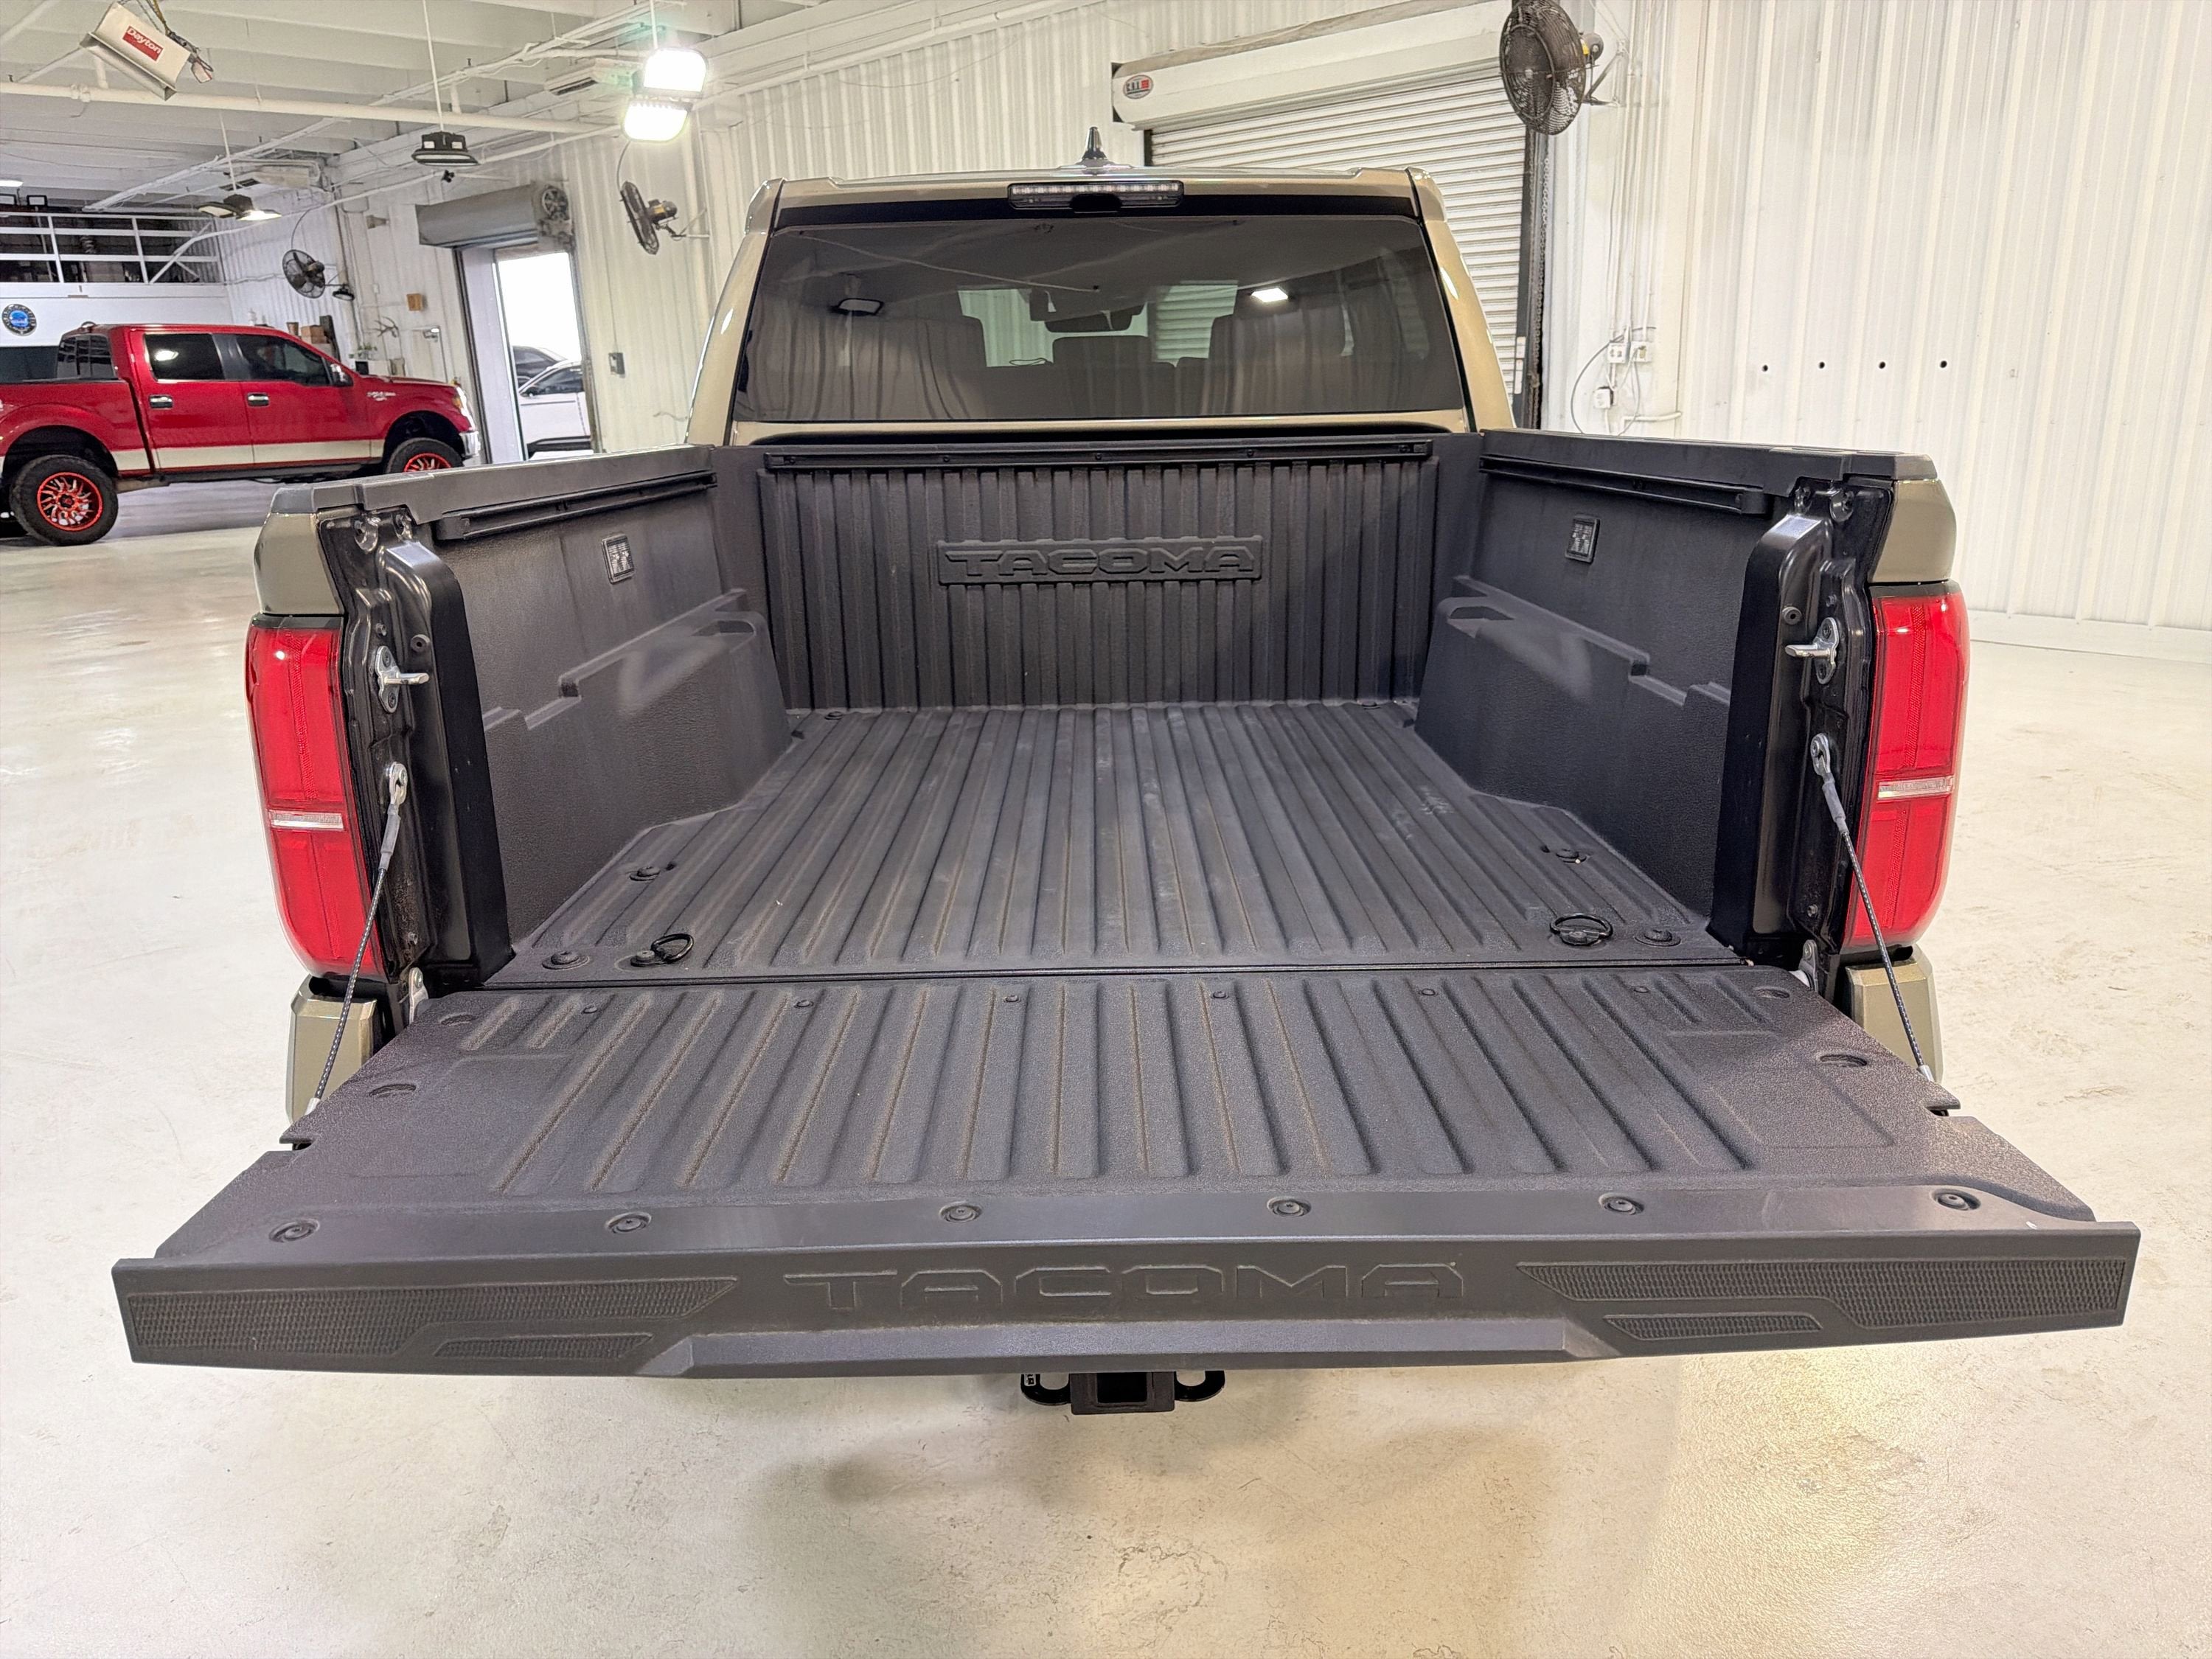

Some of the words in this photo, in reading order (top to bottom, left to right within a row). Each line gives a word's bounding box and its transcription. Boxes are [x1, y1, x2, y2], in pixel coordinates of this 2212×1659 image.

[127, 28, 162, 54] Dayton
[945, 546, 1254, 577] TACOMA
[783, 1263, 1464, 1310] TACOMA
